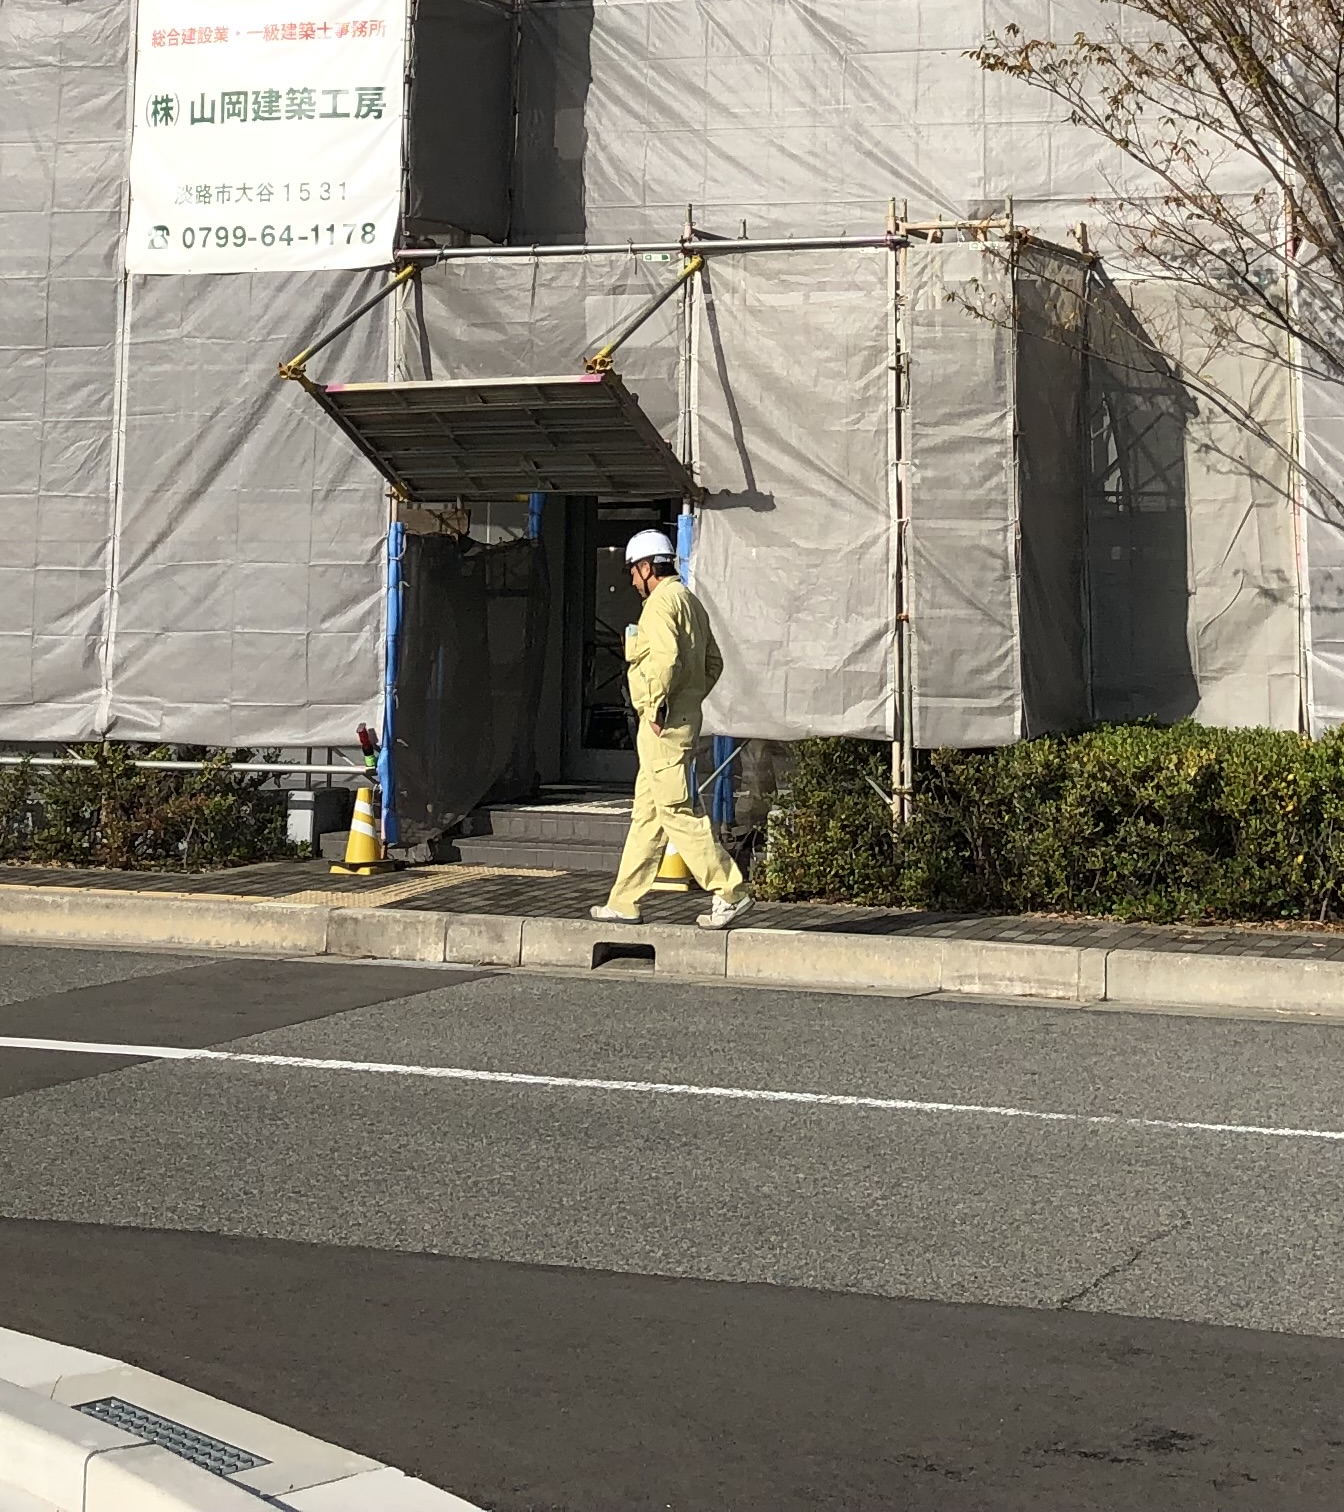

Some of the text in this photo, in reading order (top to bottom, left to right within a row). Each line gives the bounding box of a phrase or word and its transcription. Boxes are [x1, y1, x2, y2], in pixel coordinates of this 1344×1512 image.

[151, 19, 387, 48] 総合建設業・一級建築士事務所
[174, 181, 348, 206] 淡路市大谷1531
[182, 222, 376, 250] 0799-64-1178
